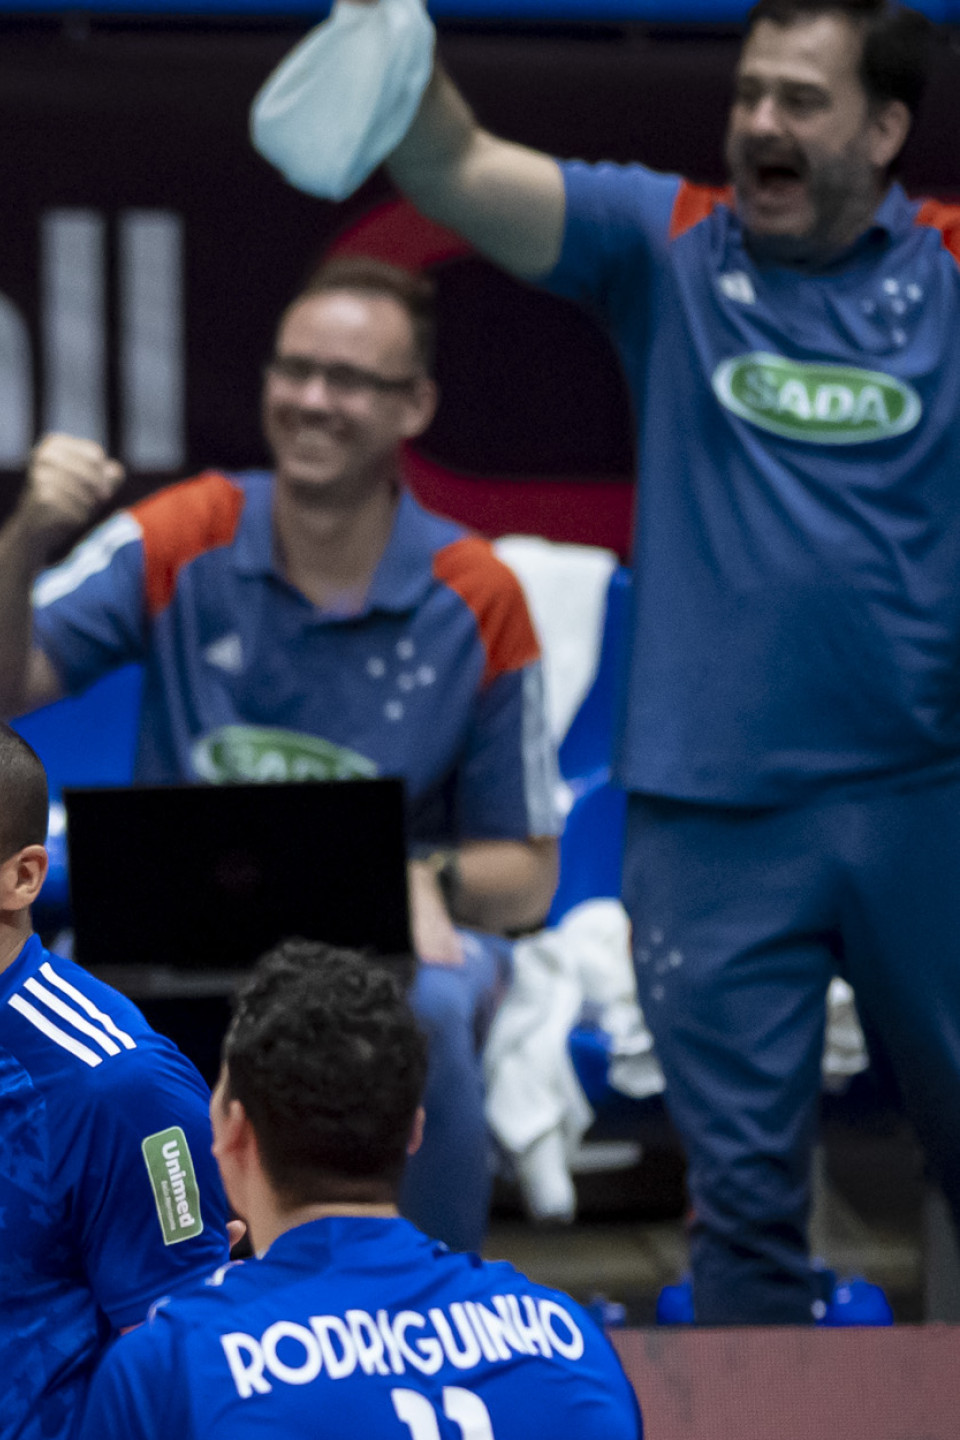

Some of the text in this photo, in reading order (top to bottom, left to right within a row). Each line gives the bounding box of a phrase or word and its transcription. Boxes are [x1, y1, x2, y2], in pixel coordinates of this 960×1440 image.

[746, 370, 893, 425] SADA
[162, 1140, 195, 1228] Unimed
[220, 1294, 585, 1399] RODRIGUINHO
